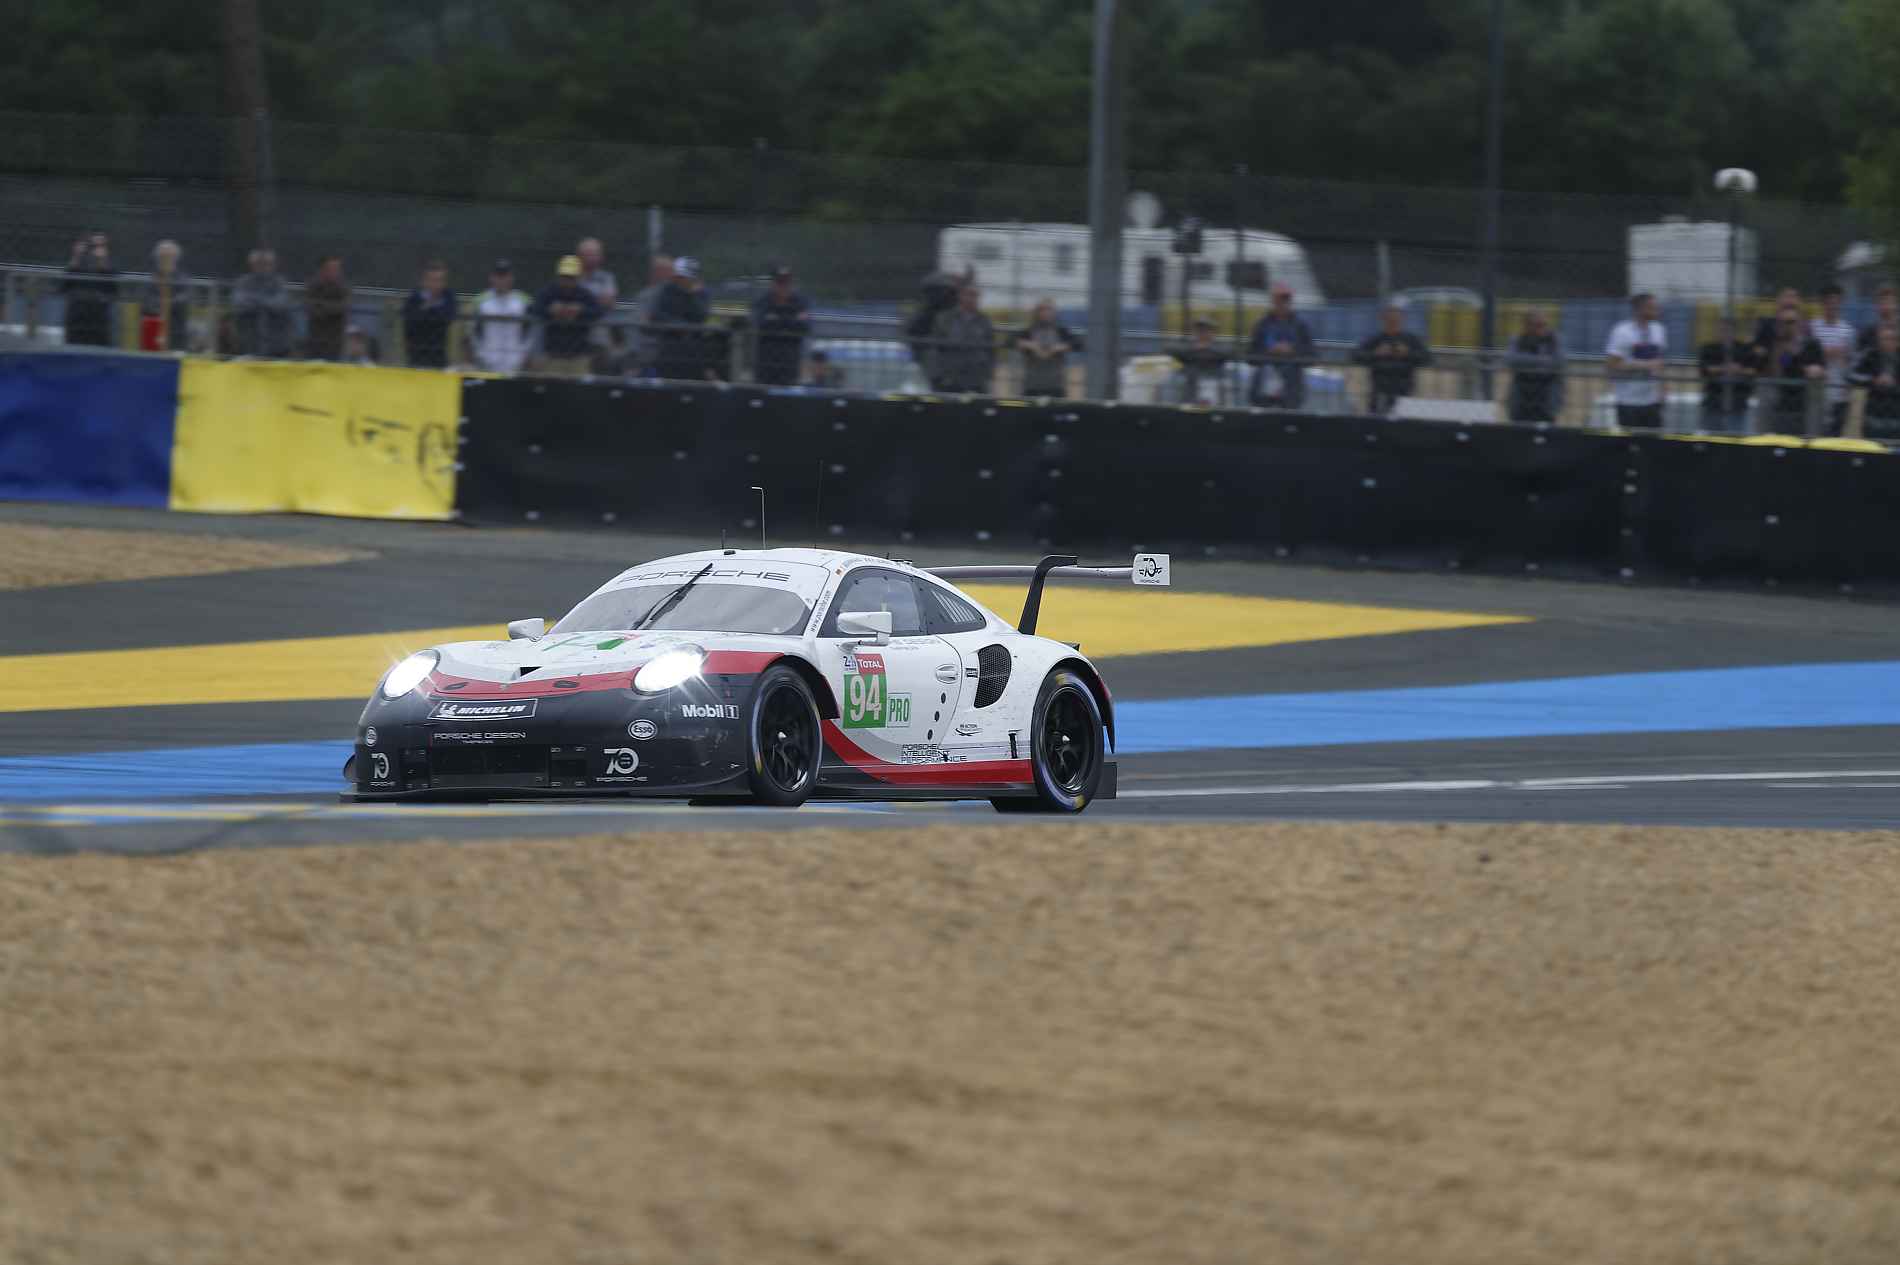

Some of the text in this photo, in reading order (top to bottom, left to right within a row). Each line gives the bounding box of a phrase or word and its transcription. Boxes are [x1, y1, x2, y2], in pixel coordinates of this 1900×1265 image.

[857, 659, 883, 669] TOTAL
[850, 674, 882, 721] 94
[456, 705, 527, 714] MICHELIN
[681, 704, 724, 718] Mobil
[889, 698, 909, 722] PRO
[633, 724, 653, 733] Esso
[433, 732, 483, 740] PORSCHE
